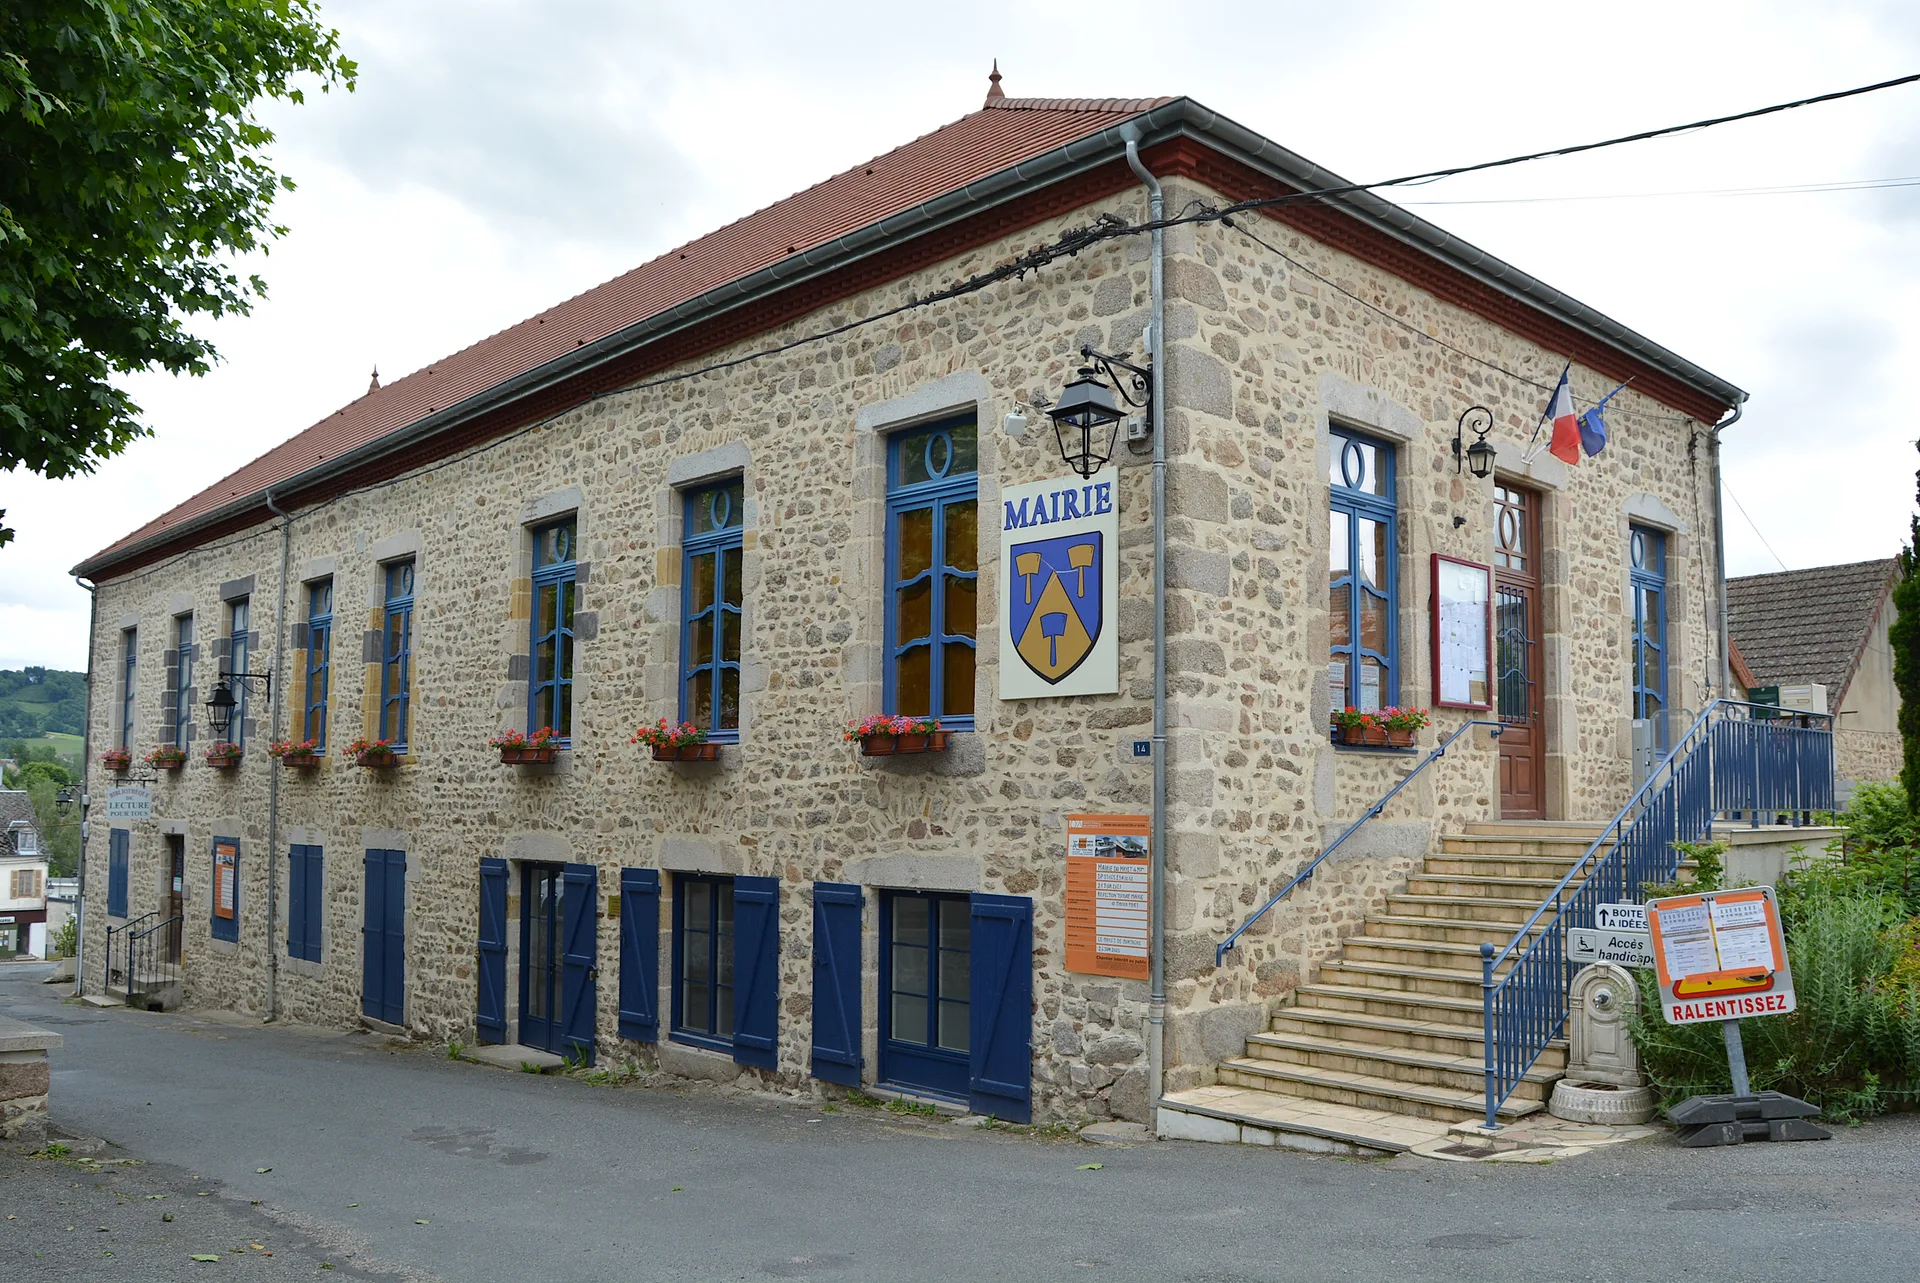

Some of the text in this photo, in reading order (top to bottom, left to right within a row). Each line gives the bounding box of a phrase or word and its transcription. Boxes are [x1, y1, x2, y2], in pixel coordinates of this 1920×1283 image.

[1004, 481, 1113, 531] MAIRIE
[1136, 744, 1146, 753] 14
[109, 801, 150, 809] LECTURE
[1612, 909, 1644, 919] BOITE
[1608, 918, 1649, 929] A IDÉES
[1608, 936, 1644, 950] Accès
[1134, 957, 1147, 965] public
[1672, 994, 1787, 1021] RALENTISSEZ
